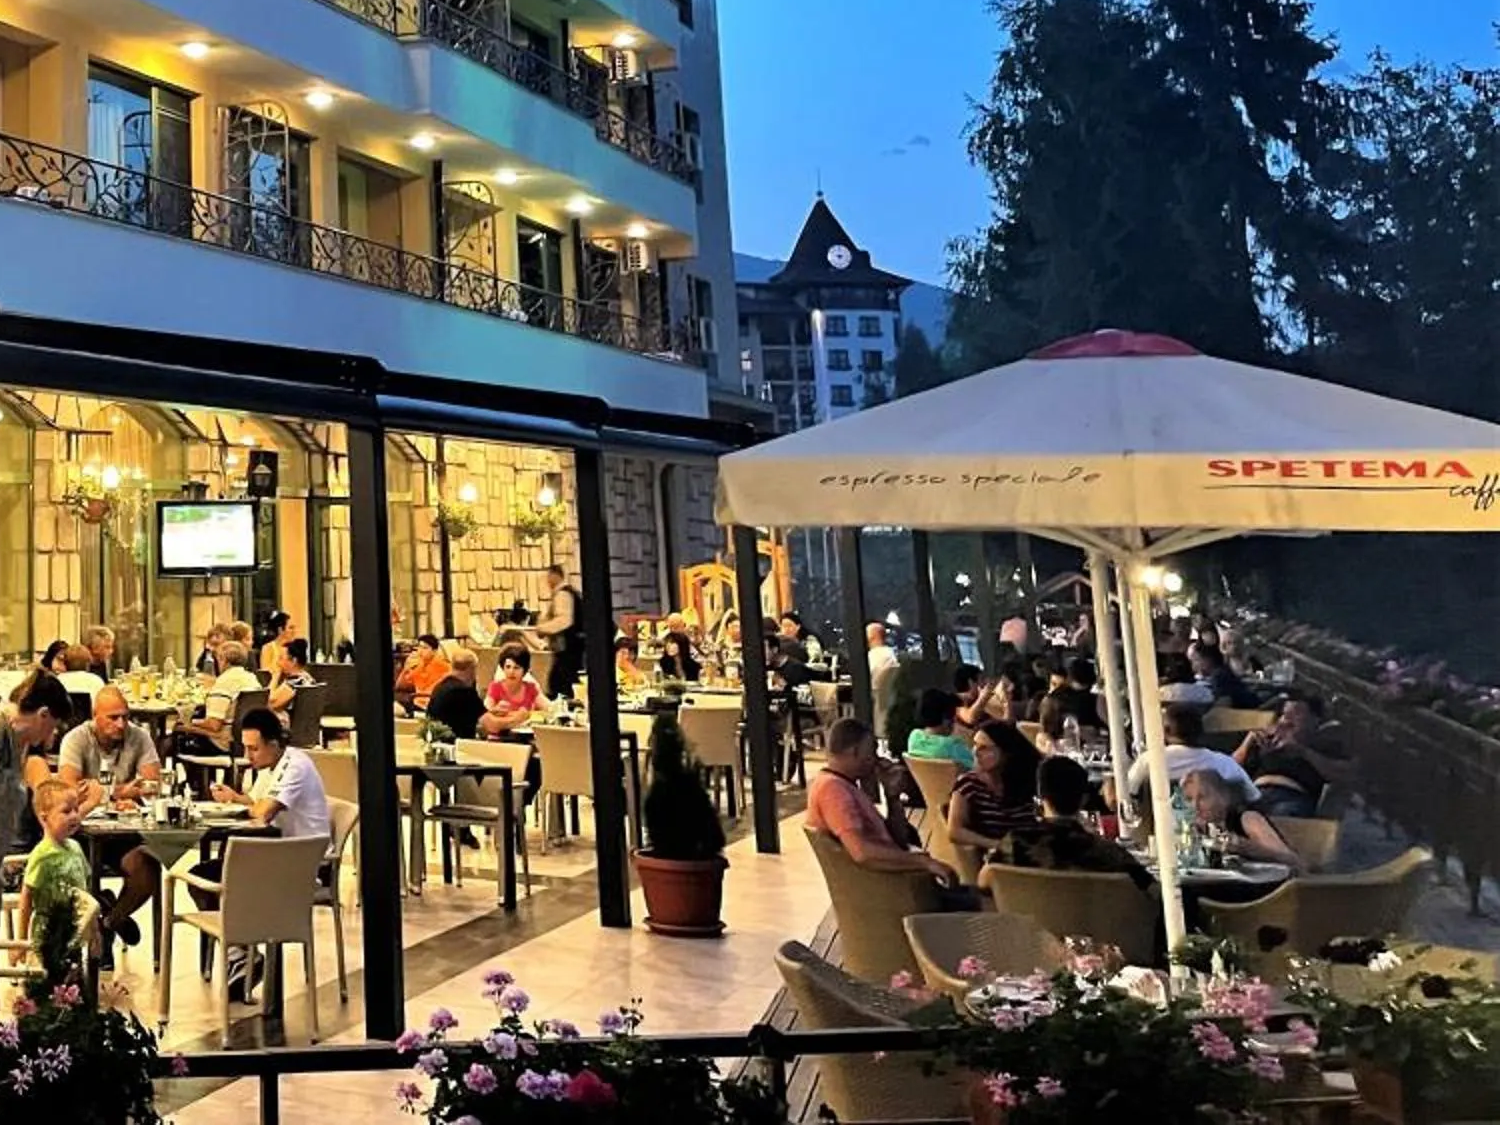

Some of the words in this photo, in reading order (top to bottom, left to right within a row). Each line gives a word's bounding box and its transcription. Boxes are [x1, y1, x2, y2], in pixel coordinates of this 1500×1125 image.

[818, 470, 947, 492] espresso
[960, 465, 1102, 492] speciale
[1207, 459, 1475, 479] SPETEMA
